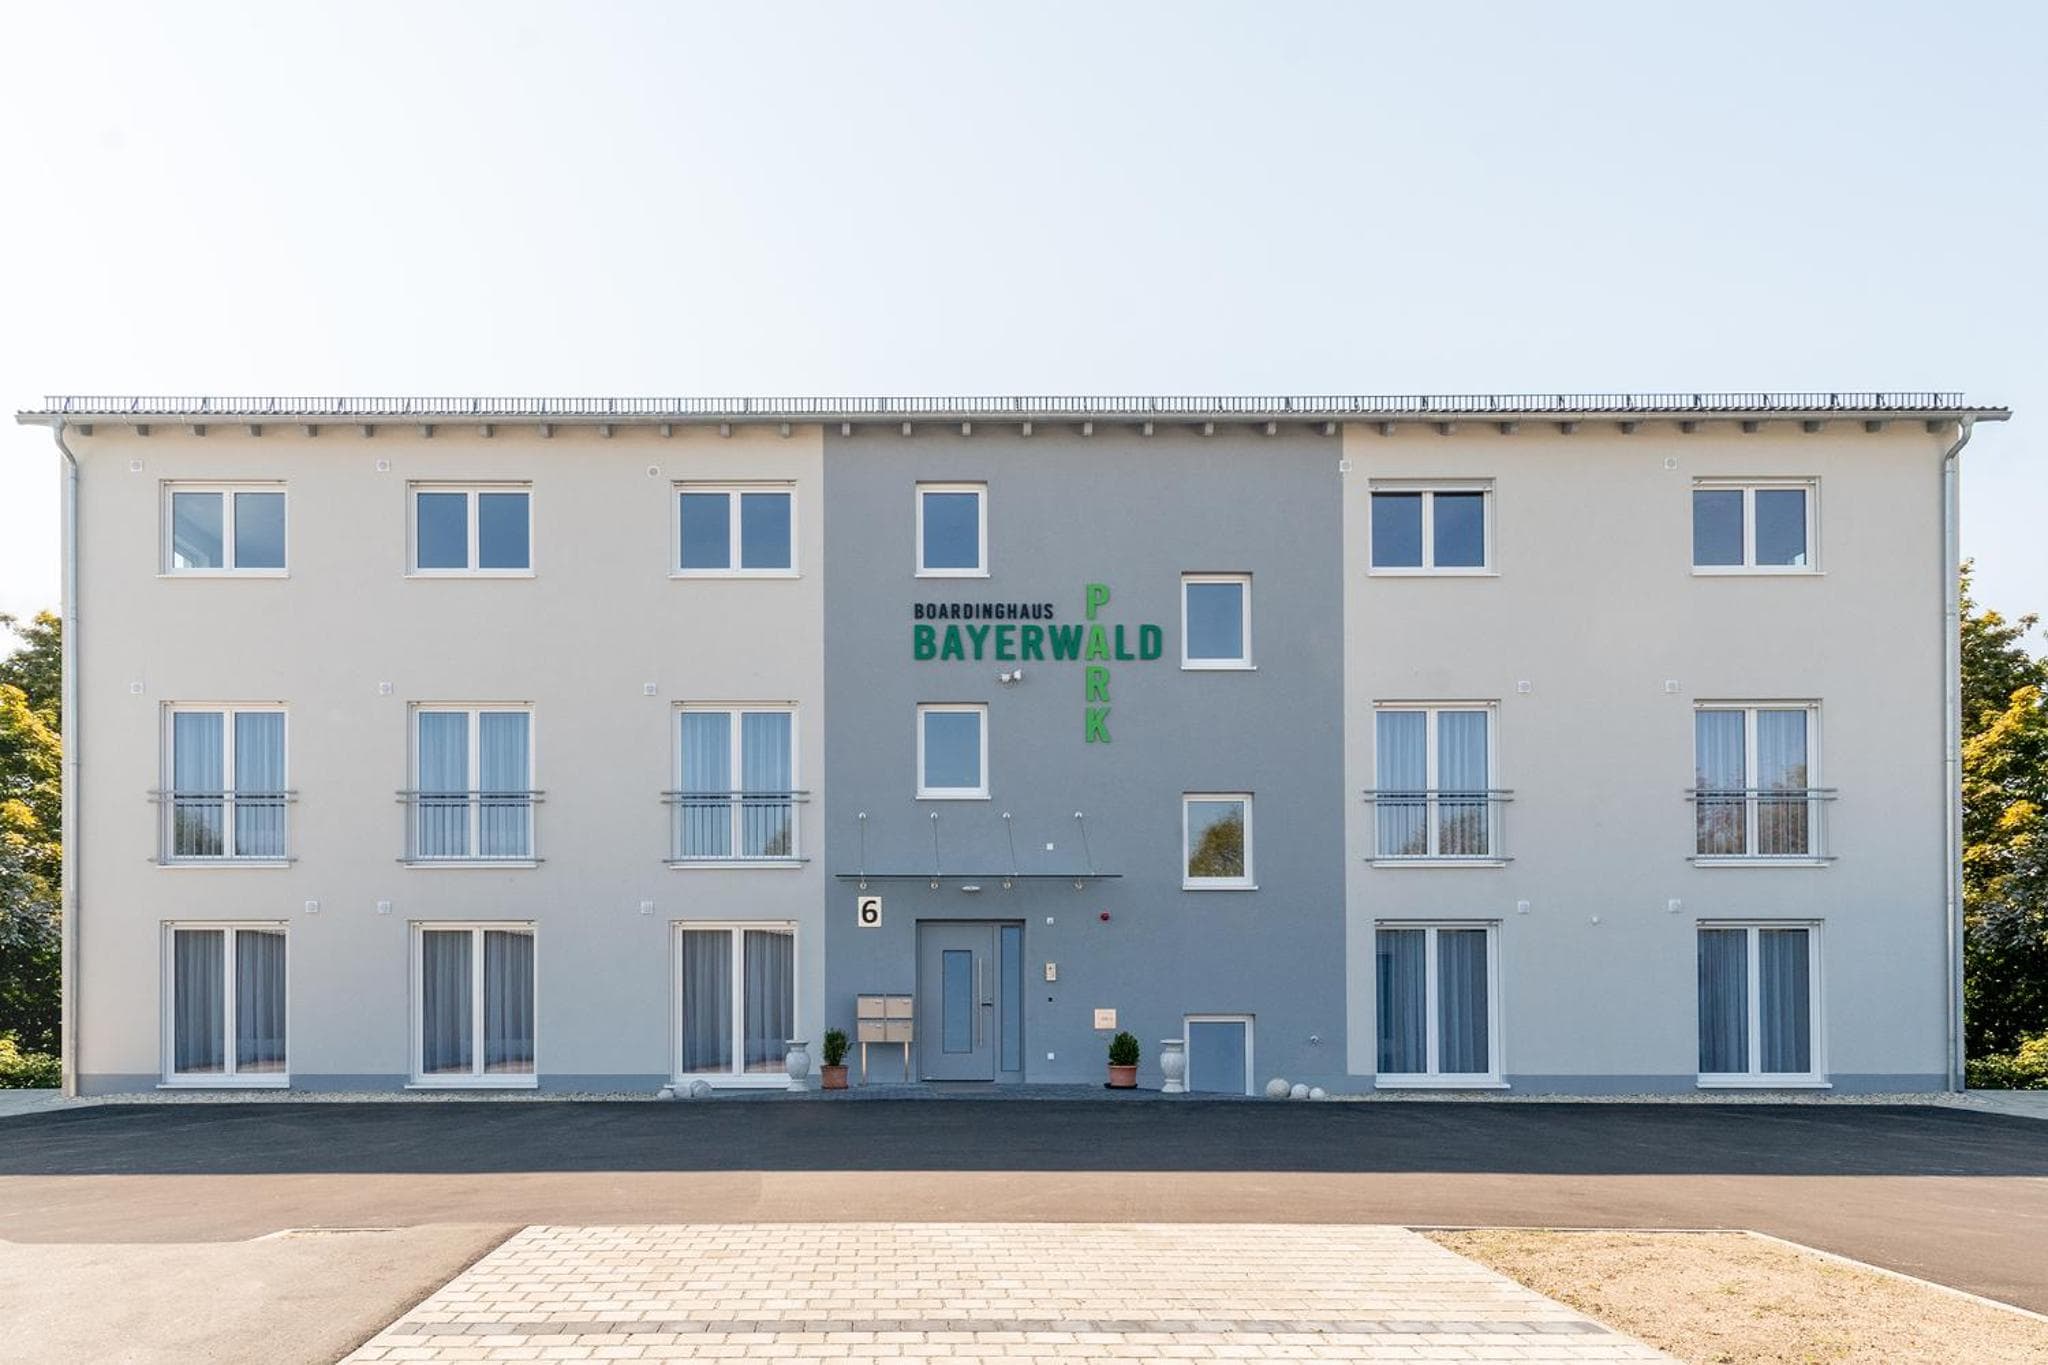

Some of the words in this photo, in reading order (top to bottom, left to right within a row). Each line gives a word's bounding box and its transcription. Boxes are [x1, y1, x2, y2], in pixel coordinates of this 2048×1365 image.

[914, 603, 1054, 620] BOARDINGHAUS
[913, 624, 1163, 661] BAYERWALD
[1085, 583, 1111, 743] PARK
[862, 900, 878, 924] 6
